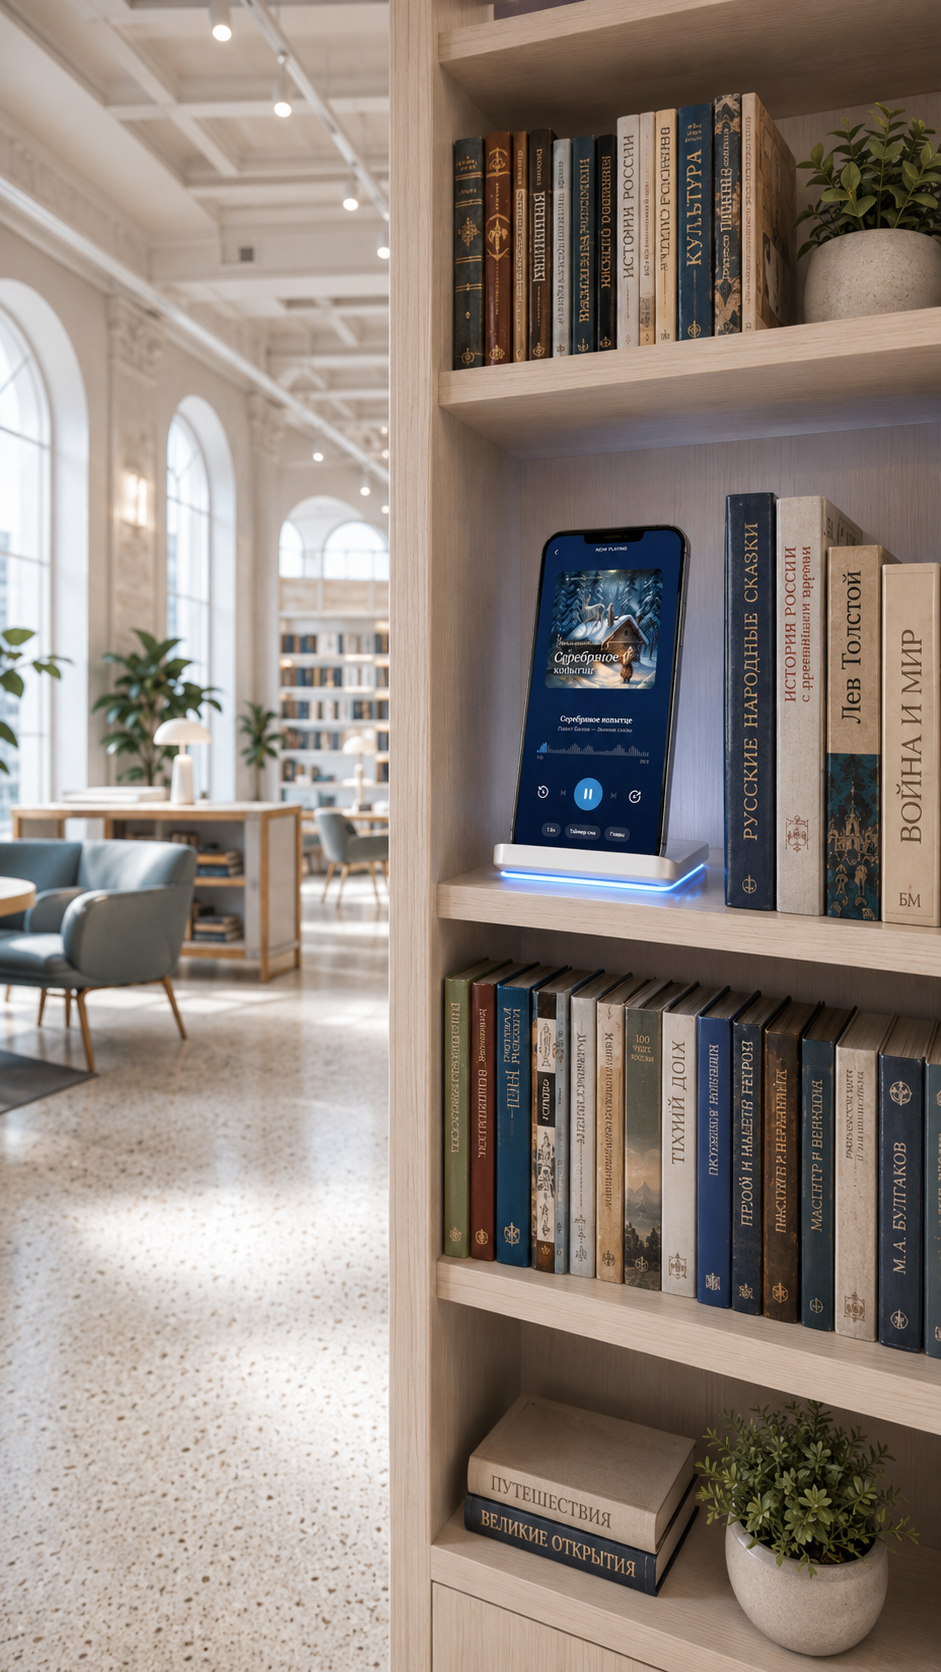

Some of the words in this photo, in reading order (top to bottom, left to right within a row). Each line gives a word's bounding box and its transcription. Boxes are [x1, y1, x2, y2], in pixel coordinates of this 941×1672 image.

[686, 148, 702, 266] КУЛЬТУРА
[743, 522, 760, 604] СКАЗКИ
[783, 546, 797, 616] РОССИИ
[838, 570, 862, 670] Толстой
[743, 612, 762, 728] НАРОДНЫЕ
[783, 622, 797, 703] ИСТОРИЯ
[900, 628, 922, 695] МИР
[841, 678, 862, 725] Лев
[900, 704, 922, 726] И
[743, 738, 760, 840] РУССКИЕ
[897, 734, 923, 844] ВОЙНА
[898, 892, 921, 908] БМ
[636, 1034, 650, 1044] 100
[892, 1142, 907, 1232] БУЛГАКОВ
[491, 1475, 612, 1529] ПУТЕШЕСТВИЯ
[480, 1509, 548, 1548] ВЕЛИКИЕ
[552, 1534, 636, 1578] ОТКРЫТИЯ
